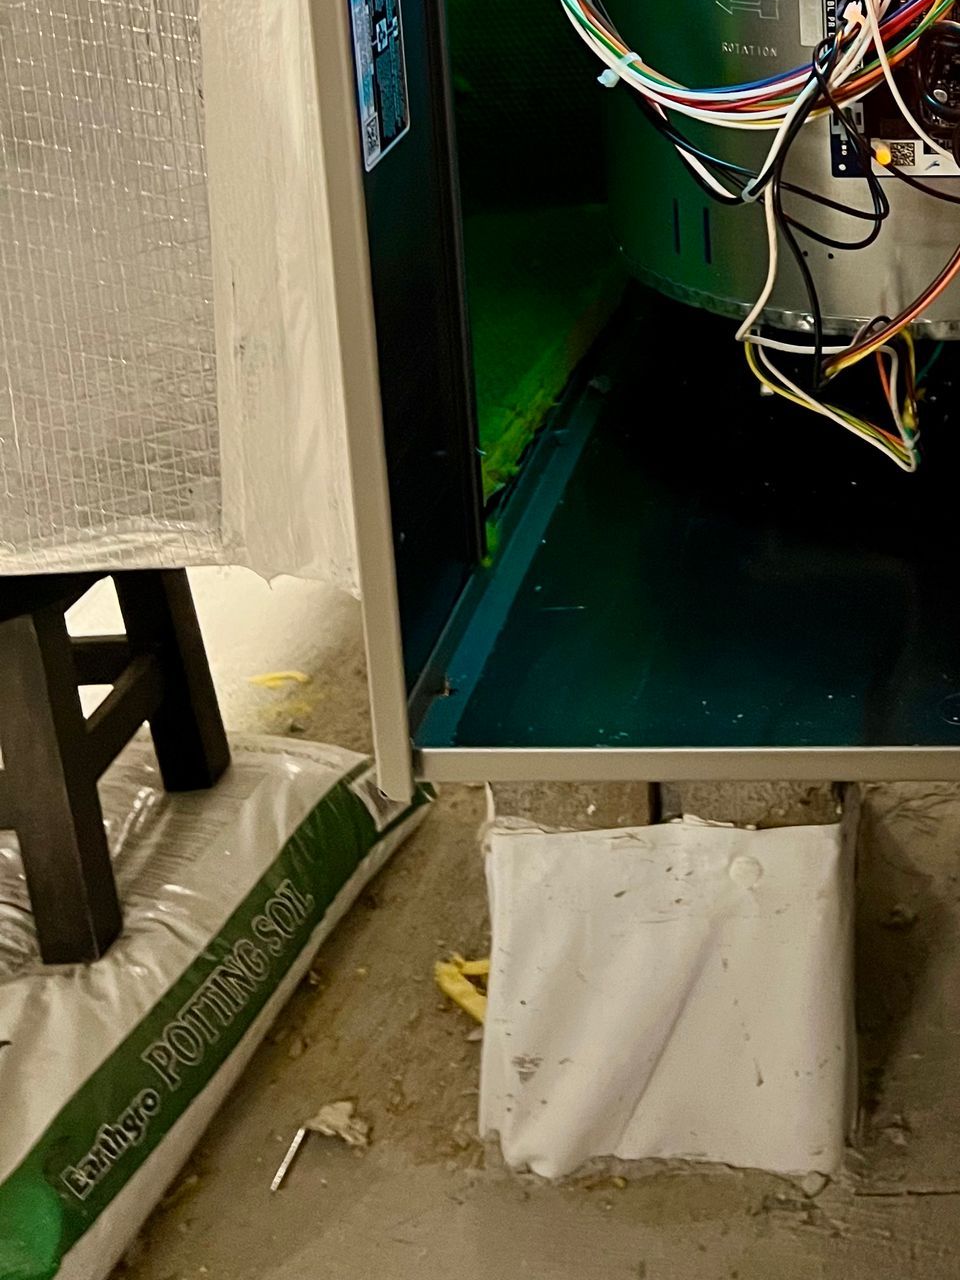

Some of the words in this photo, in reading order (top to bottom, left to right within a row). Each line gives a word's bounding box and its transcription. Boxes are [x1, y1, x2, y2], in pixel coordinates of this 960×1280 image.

[721, 41, 778, 58] ROTATION
[141, 939, 270, 1091] POTTING
[252, 878, 314, 957] SOIL
